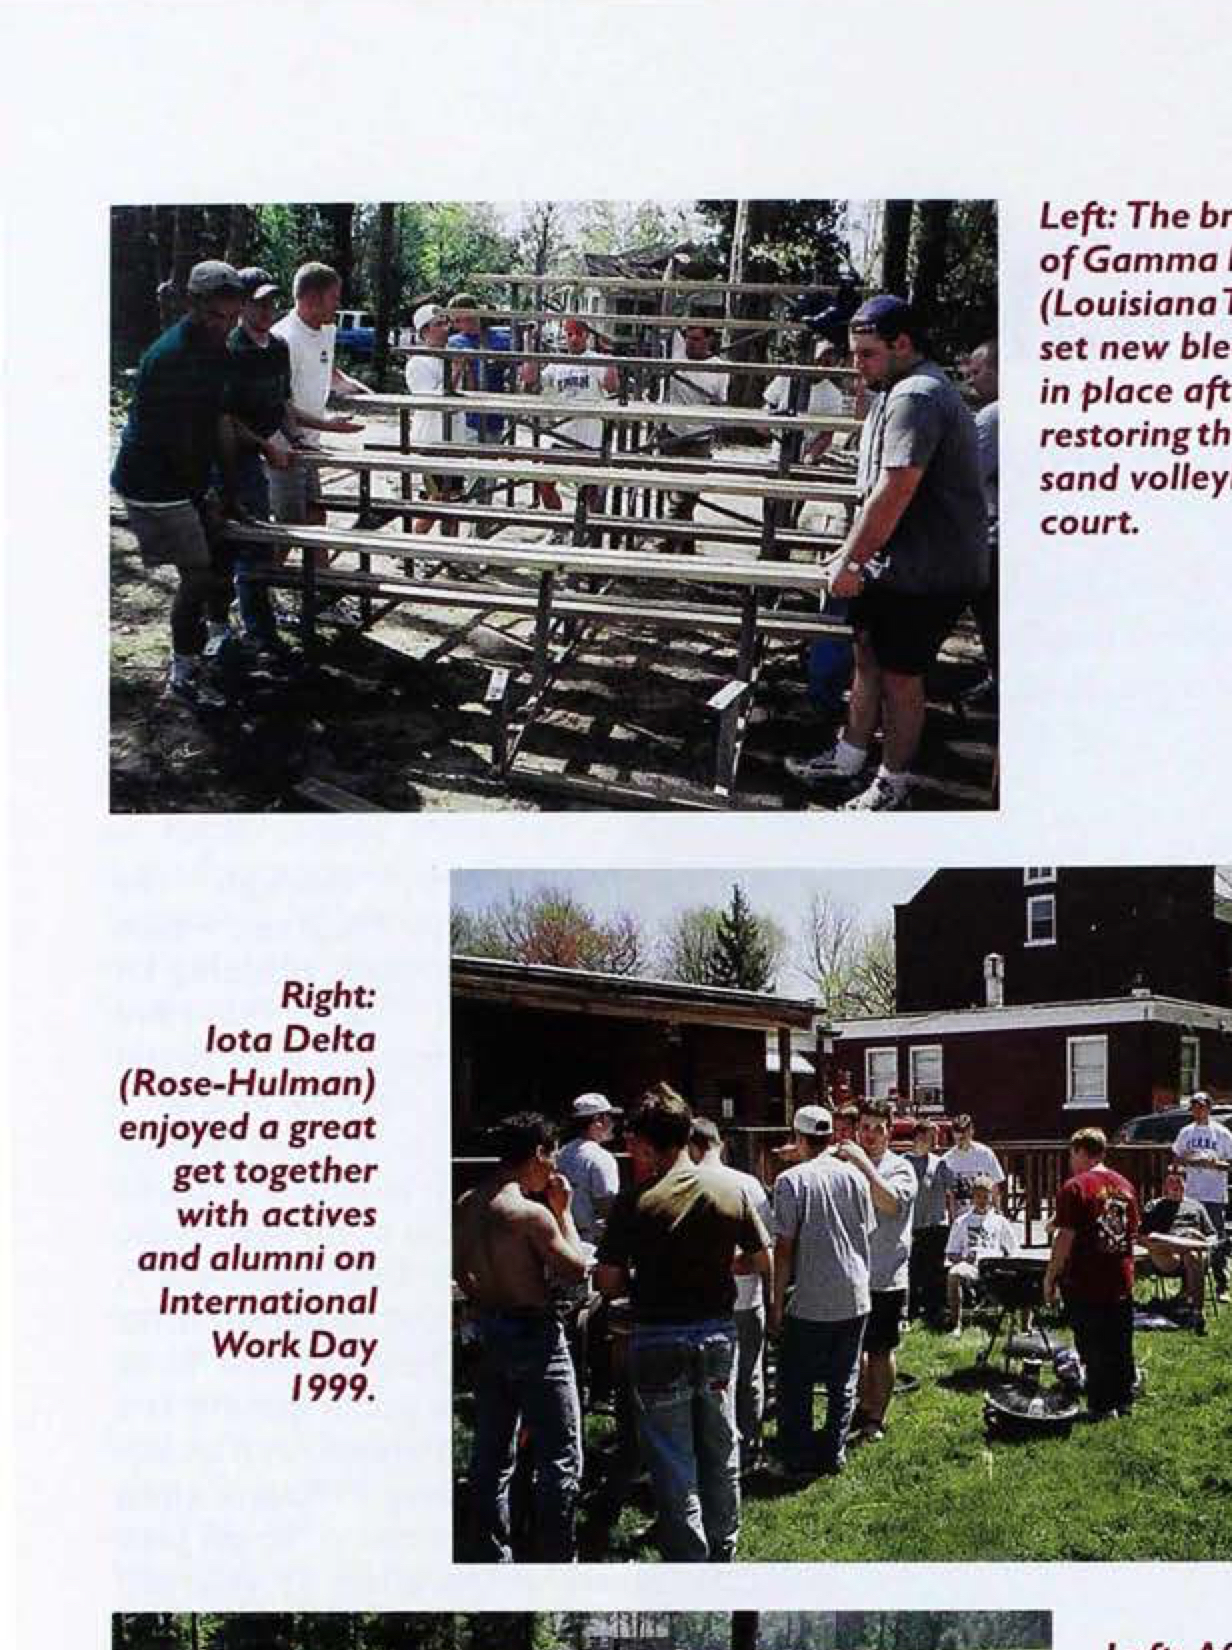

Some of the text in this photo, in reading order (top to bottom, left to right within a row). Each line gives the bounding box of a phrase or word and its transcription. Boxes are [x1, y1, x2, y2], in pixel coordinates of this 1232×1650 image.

[1039, 200, 1117, 238] Left:
[1127, 200, 1191, 230] The
[1039, 244, 1081, 282] of
[1083, 244, 1219, 274] Gamma
[1039, 288, 1217, 326] (Louisiana
[1039, 337, 1089, 362] set
[1099, 340, 1171, 360] new
[1040, 377, 1071, 404] in
[1081, 375, 1173, 414] place
[1039, 420, 1193, 456] restoring
[1039, 462, 1120, 492] sand
[1040, 511, 1139, 536] court.
[281, 980, 376, 1018] Right:
[206, 1024, 376, 1054] Iota Delta
[119, 1066, 375, 1106] (Rose-Hulman)
[119, 1111, 377, 1150] enjoyed a great
[172, 1154, 379, 1194] get together
[177, 1198, 377, 1228] with actives
[137, 1242, 376, 1272] and alumni on
[159, 1286, 379, 1316] International
[212, 1330, 379, 1368] Work Day
[292, 1372, 375, 1402] 1999.
